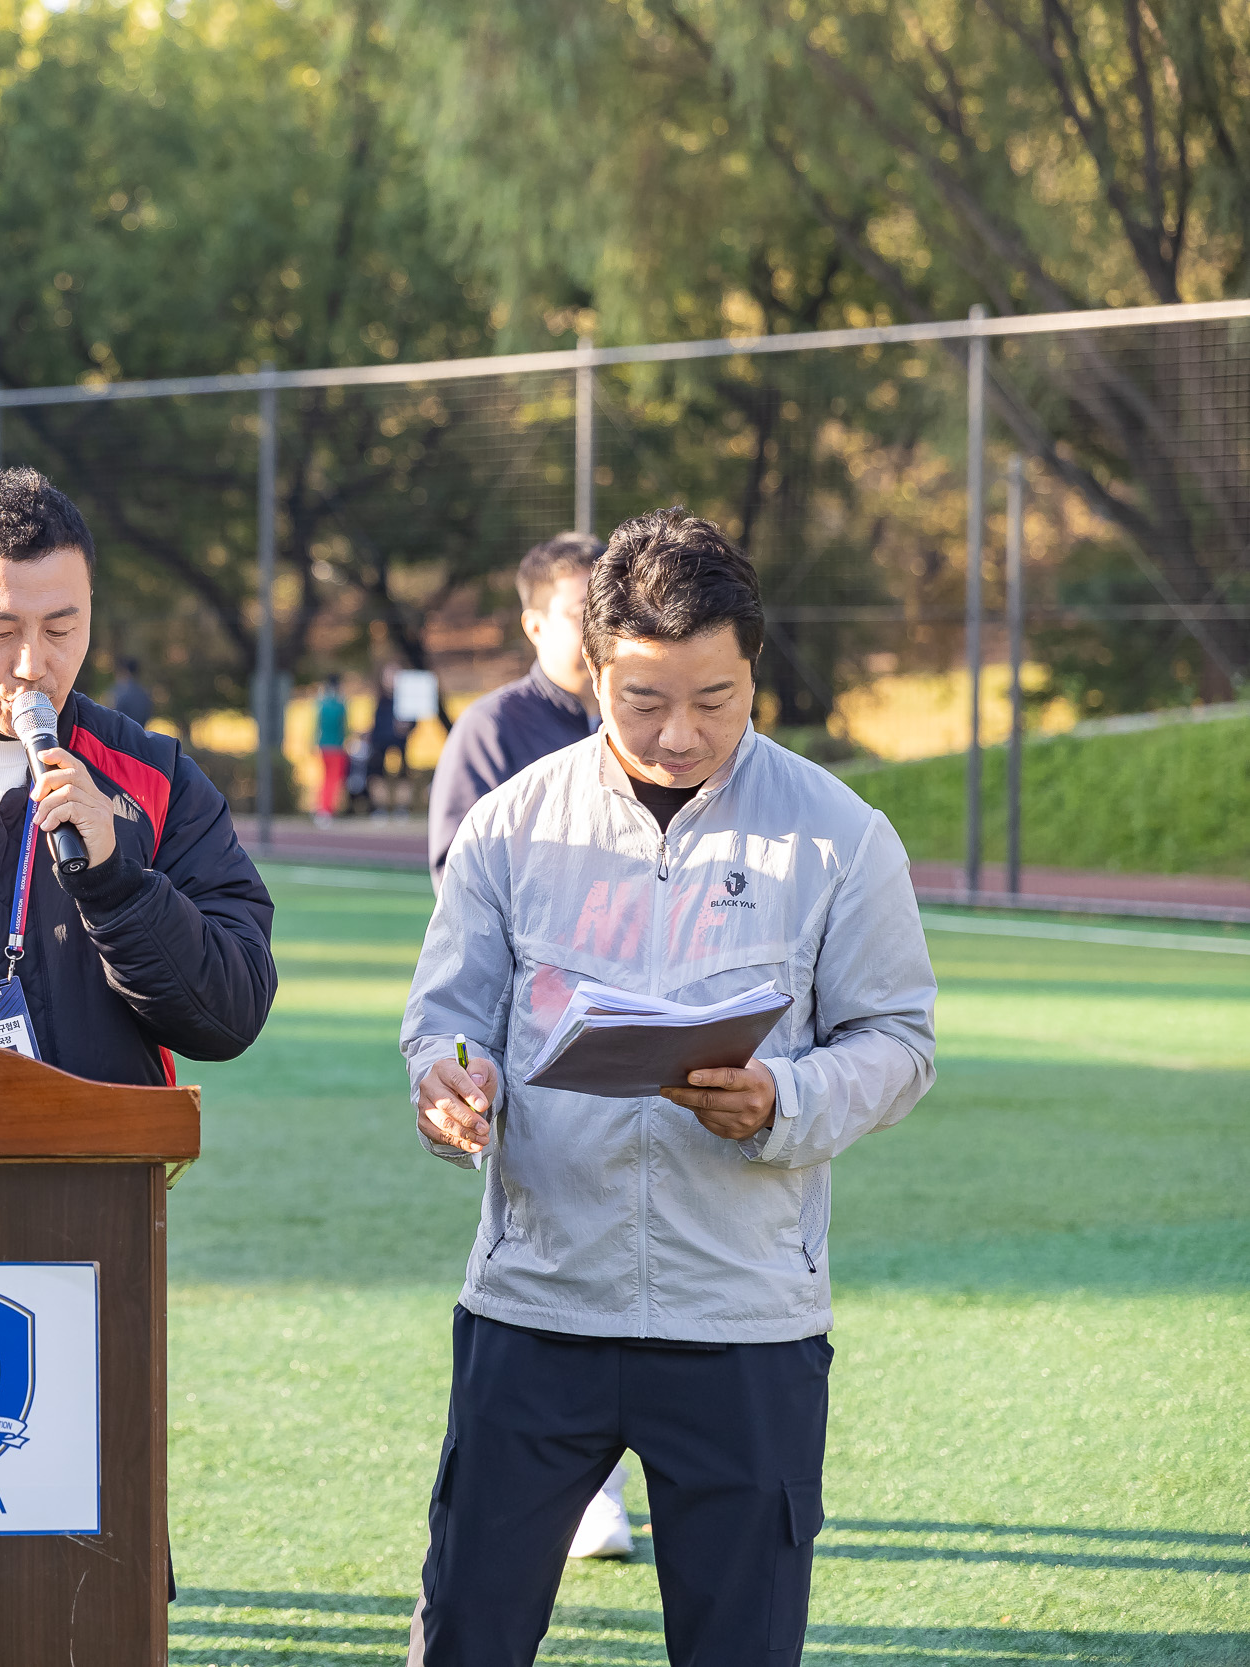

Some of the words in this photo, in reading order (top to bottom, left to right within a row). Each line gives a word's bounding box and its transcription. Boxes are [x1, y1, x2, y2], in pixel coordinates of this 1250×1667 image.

[25, 822, 34, 851] ASSOCIATION
[22, 852, 30, 875] FOOTBALL
[15, 898, 23, 930] ASSOCIATION
[710, 899, 738, 908] BLACK
[739, 900, 757, 909] YAK
